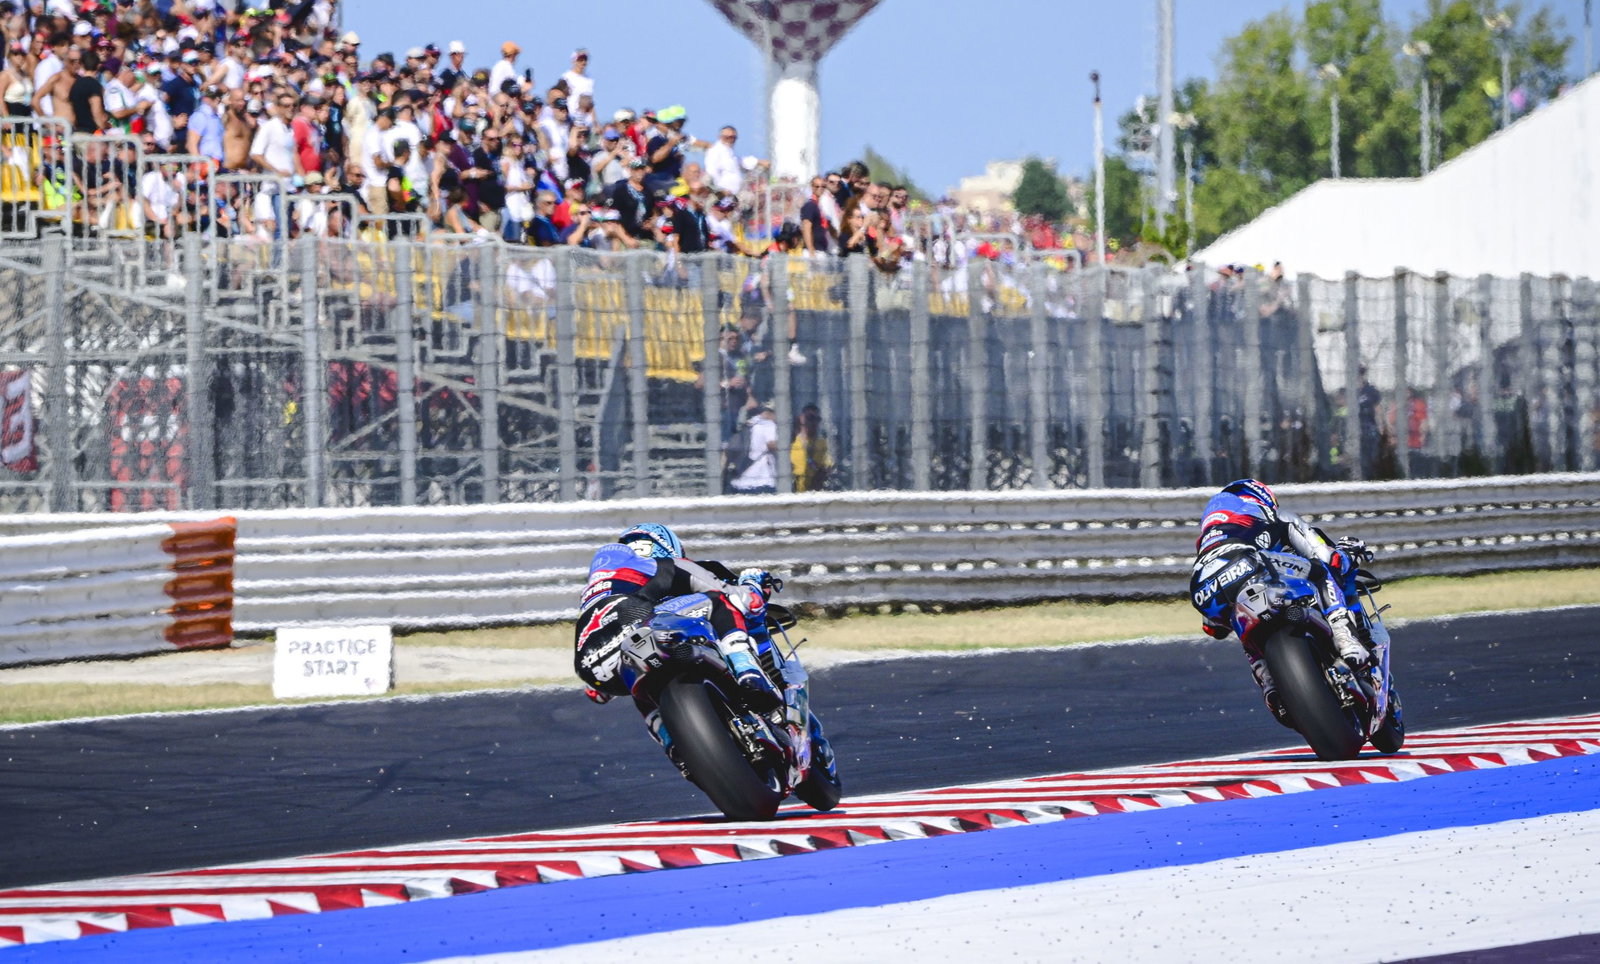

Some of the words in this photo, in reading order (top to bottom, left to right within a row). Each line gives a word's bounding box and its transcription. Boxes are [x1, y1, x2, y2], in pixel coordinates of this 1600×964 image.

[1271, 558, 1303, 572] XON
[1194, 560, 1254, 606] OLIVEIRA
[288, 639, 377, 655] PRACTICE
[303, 659, 360, 677] START
